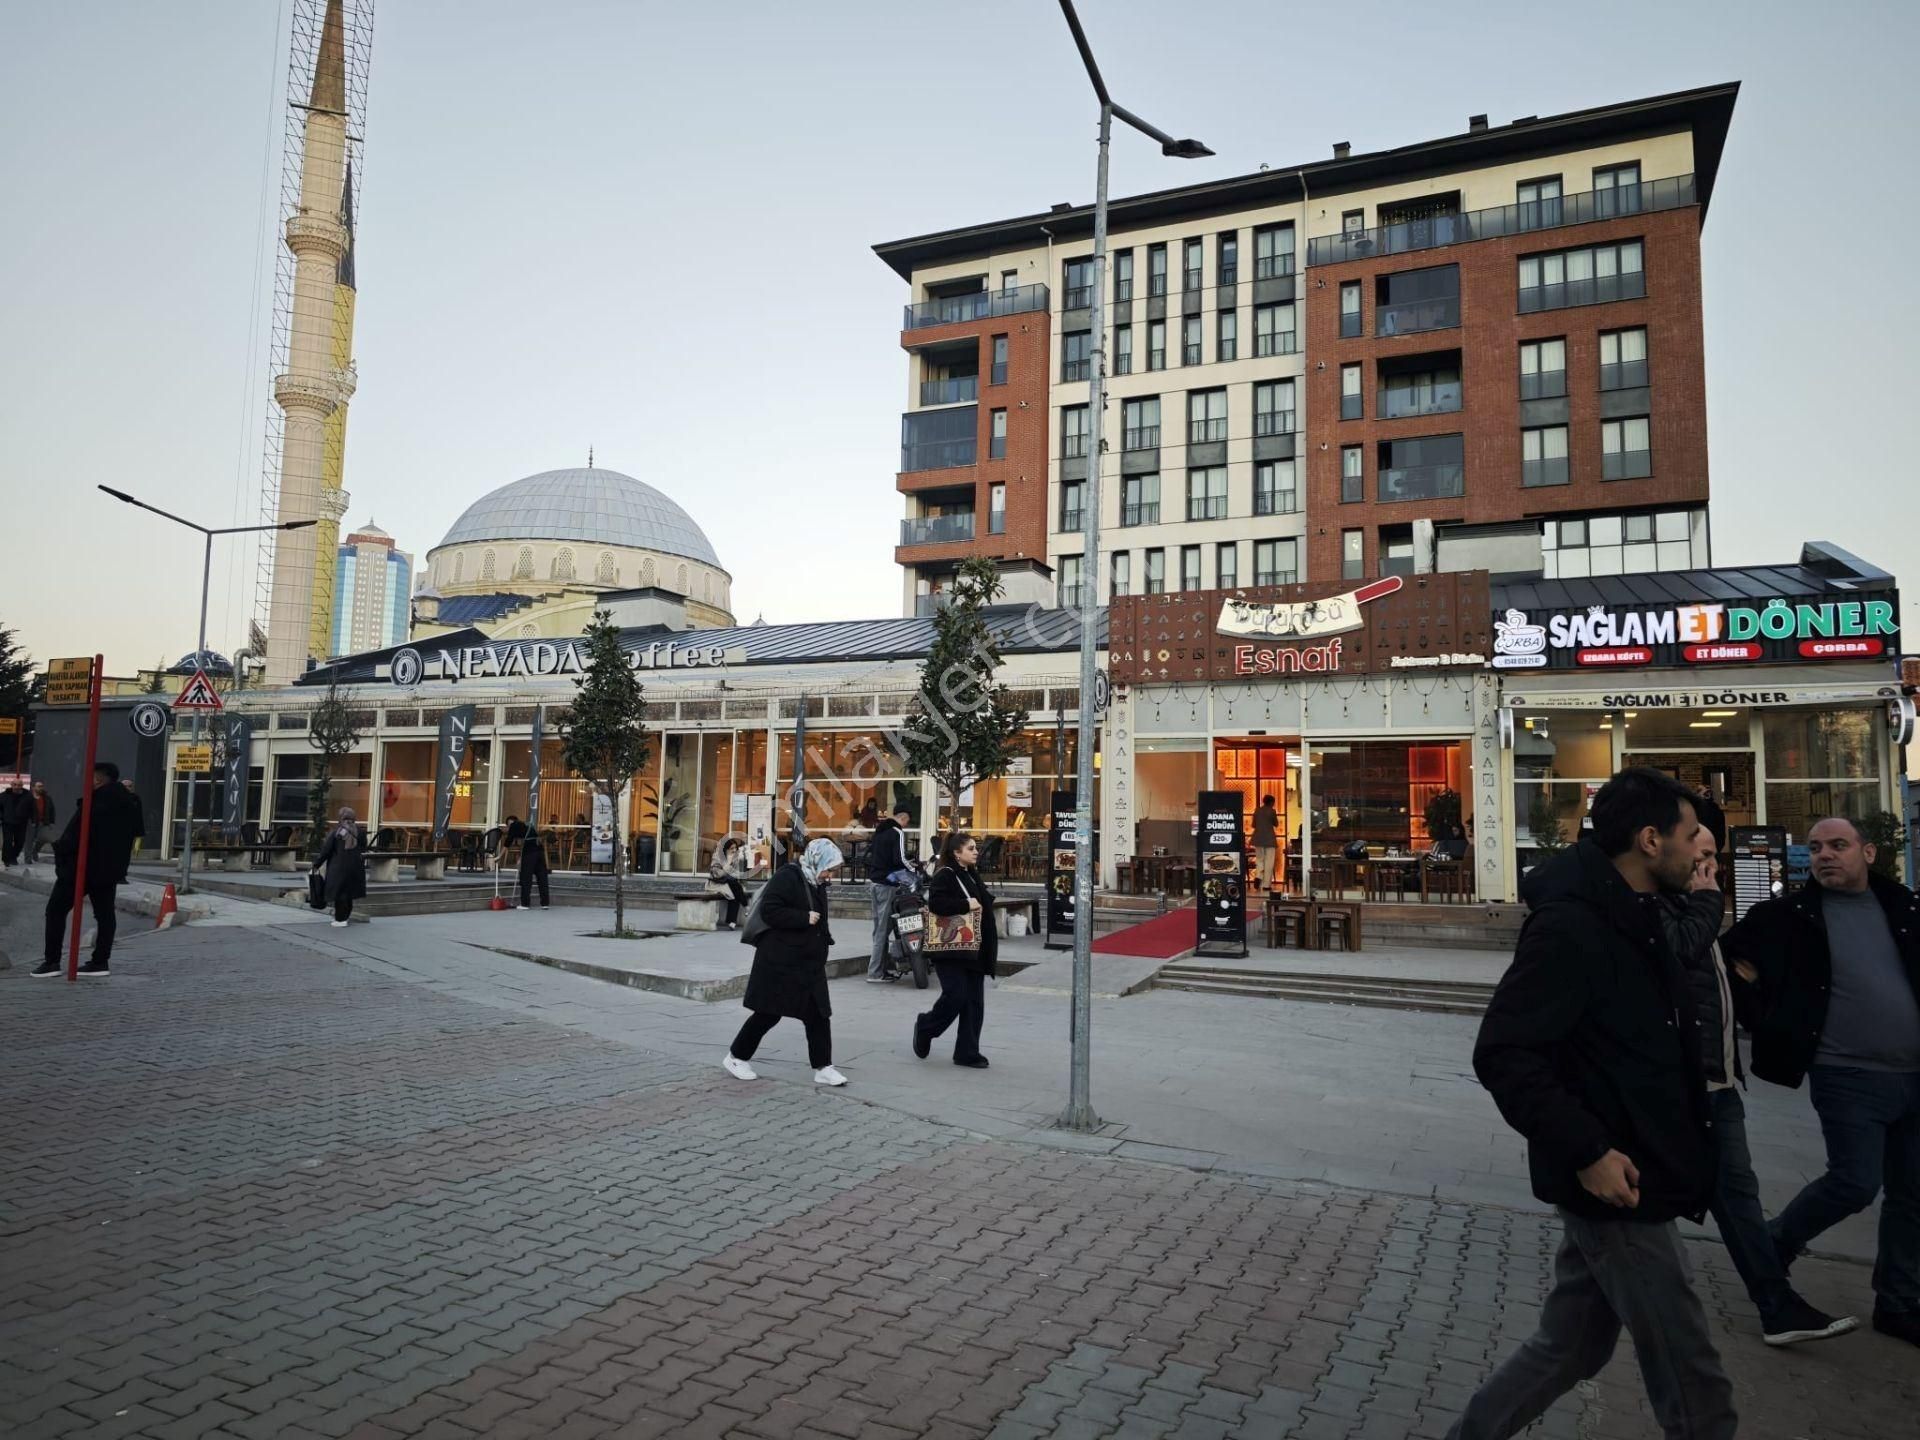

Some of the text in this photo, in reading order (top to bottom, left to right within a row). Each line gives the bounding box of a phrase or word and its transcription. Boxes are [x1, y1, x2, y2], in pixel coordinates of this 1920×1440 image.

[1676, 604, 1724, 643] ET
[1727, 599, 1900, 641] DÖNER
[1235, 637, 1342, 675] Esnaf
[1696, 646, 1748, 659] ET DÖNER
[1813, 643, 1868, 654] ÇORBA
[438, 641, 725, 679] NEVADA offee
[1702, 689, 1790, 706] DÖNER
[1058, 819, 1077, 829] DÜRÜ
[1206, 821, 1236, 830] DÜRÜM
